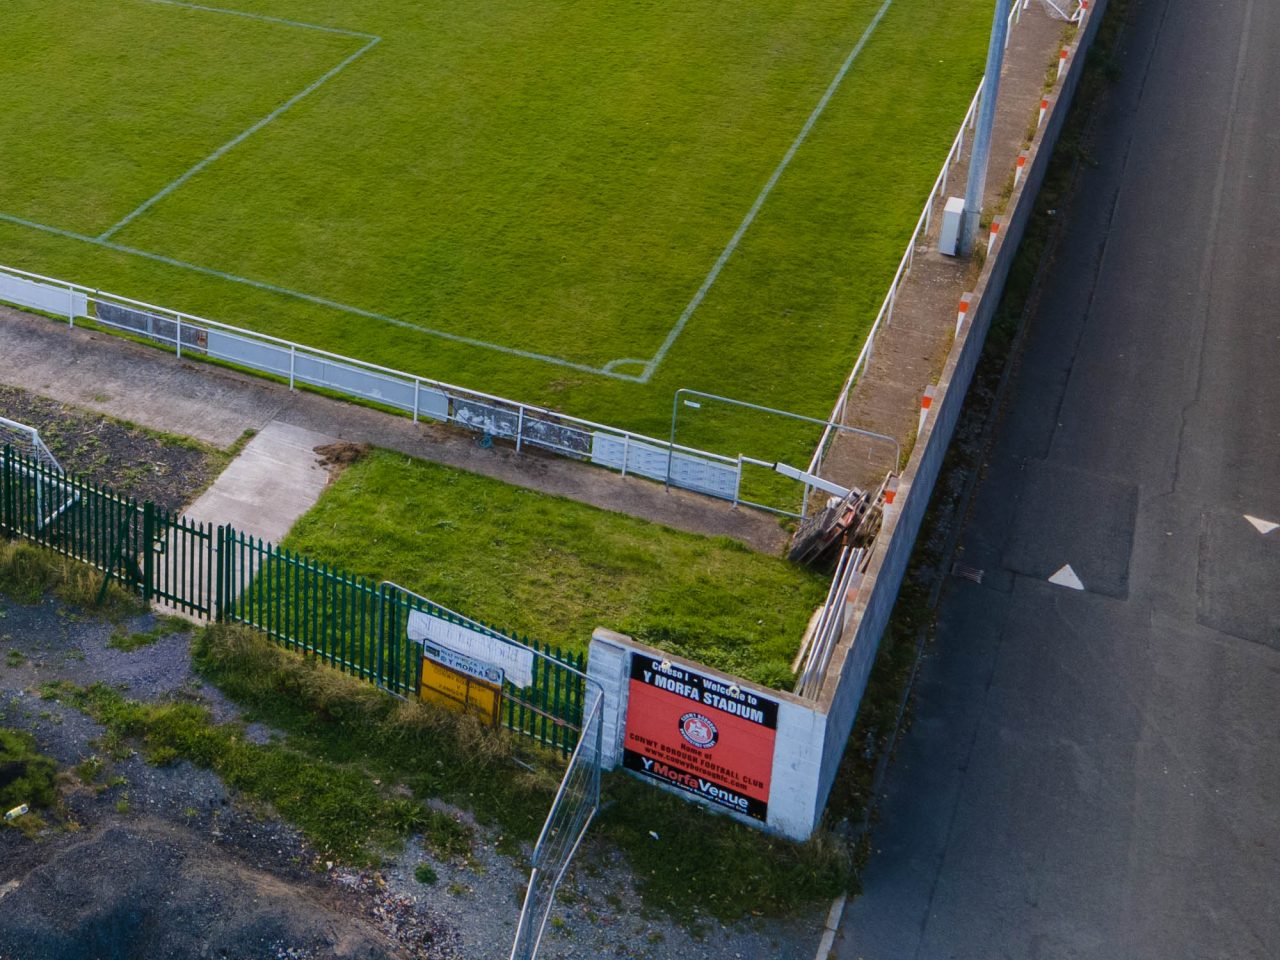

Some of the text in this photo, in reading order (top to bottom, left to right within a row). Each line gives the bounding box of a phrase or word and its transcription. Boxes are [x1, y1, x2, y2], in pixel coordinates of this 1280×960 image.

[643, 670, 764, 723] Y MORFA STADIUM
[747, 694, 758, 706] to
[629, 733, 658, 749] CONWY
[660, 744, 698, 764] BOROUGH
[700, 759, 740, 780] FOOTBALL
[742, 775, 765, 789] CLUB
[644, 747, 748, 790] www.conwyboroughfc.com
[680, 743, 713, 760] Home of
